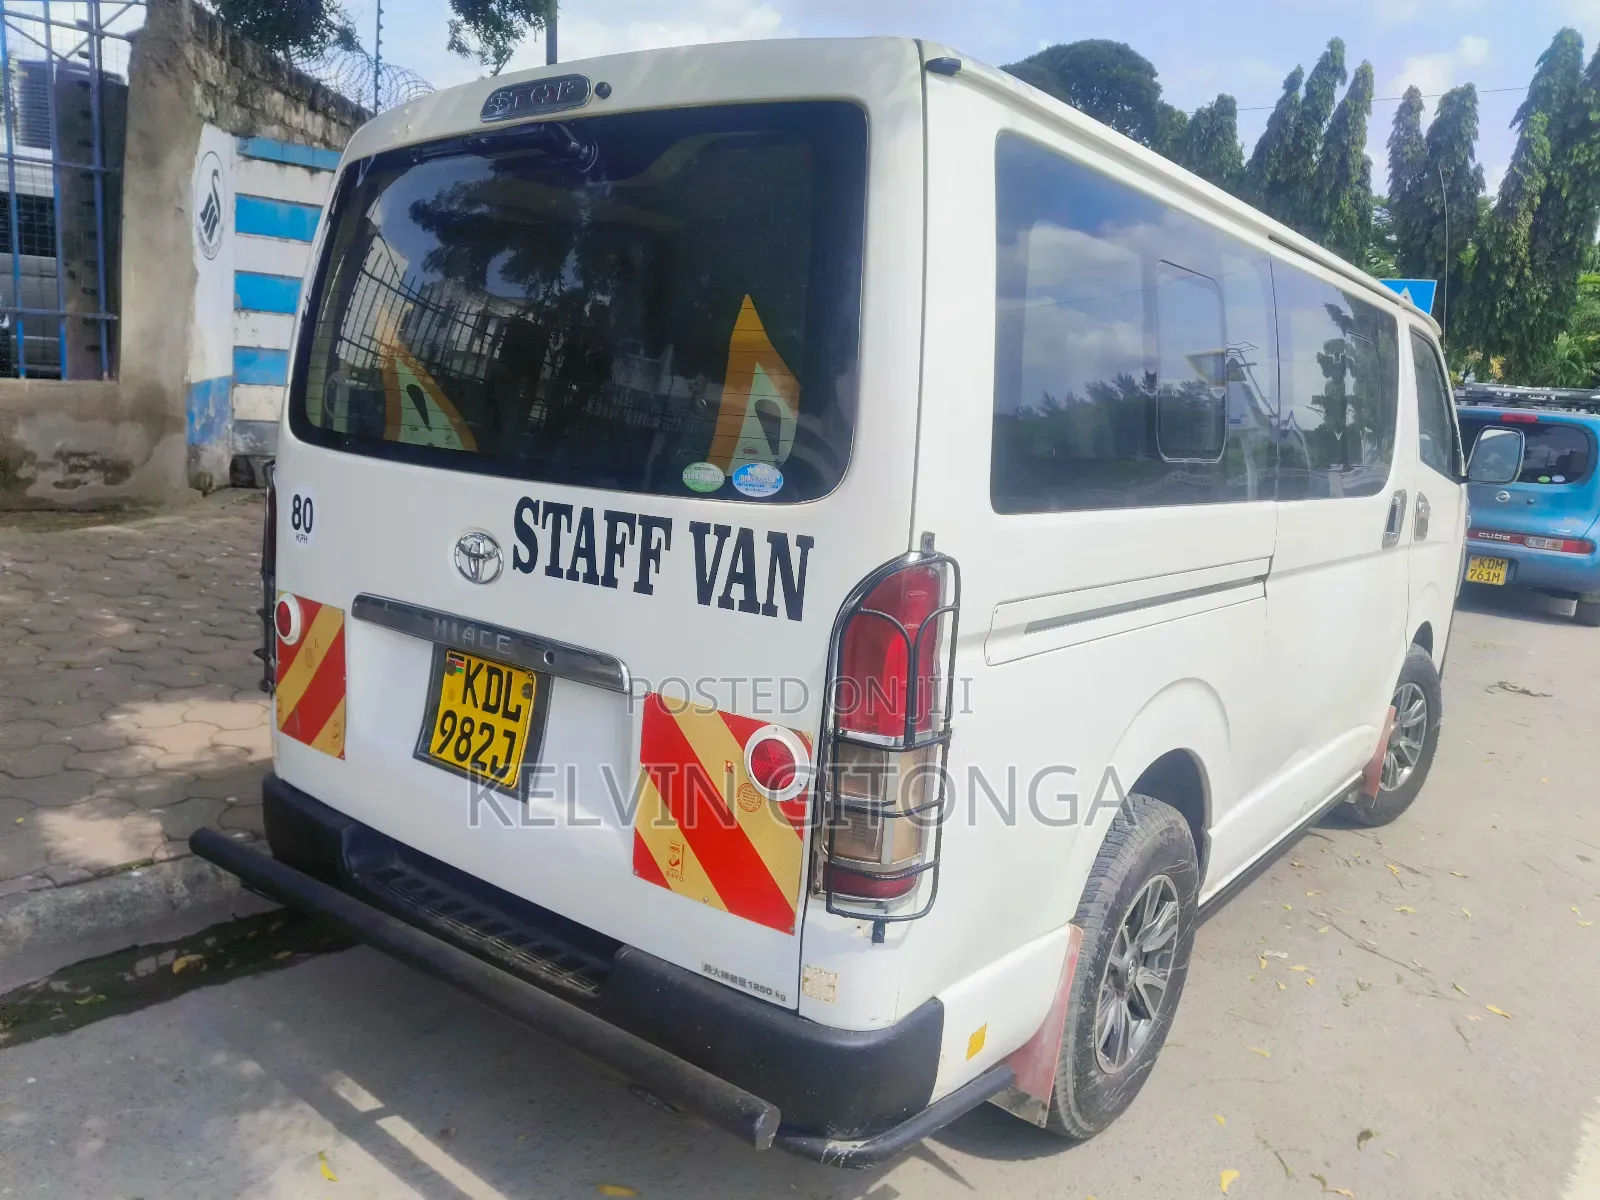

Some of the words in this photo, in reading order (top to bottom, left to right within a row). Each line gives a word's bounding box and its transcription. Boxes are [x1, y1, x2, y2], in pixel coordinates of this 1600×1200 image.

[488, 79, 581, 114] STOP
[292, 493, 314, 534] 80
[295, 533, 308, 544] KPH
[511, 495, 673, 596] STAFF
[688, 520, 815, 622] VAN
[1470, 569, 1501, 583] 761M
[1478, 558, 1506, 571] KDM
[433, 617, 511, 656] HIACE
[462, 658, 522, 723] KDL
[436, 709, 518, 779] 982J
[775, 990, 786, 1002] kg
